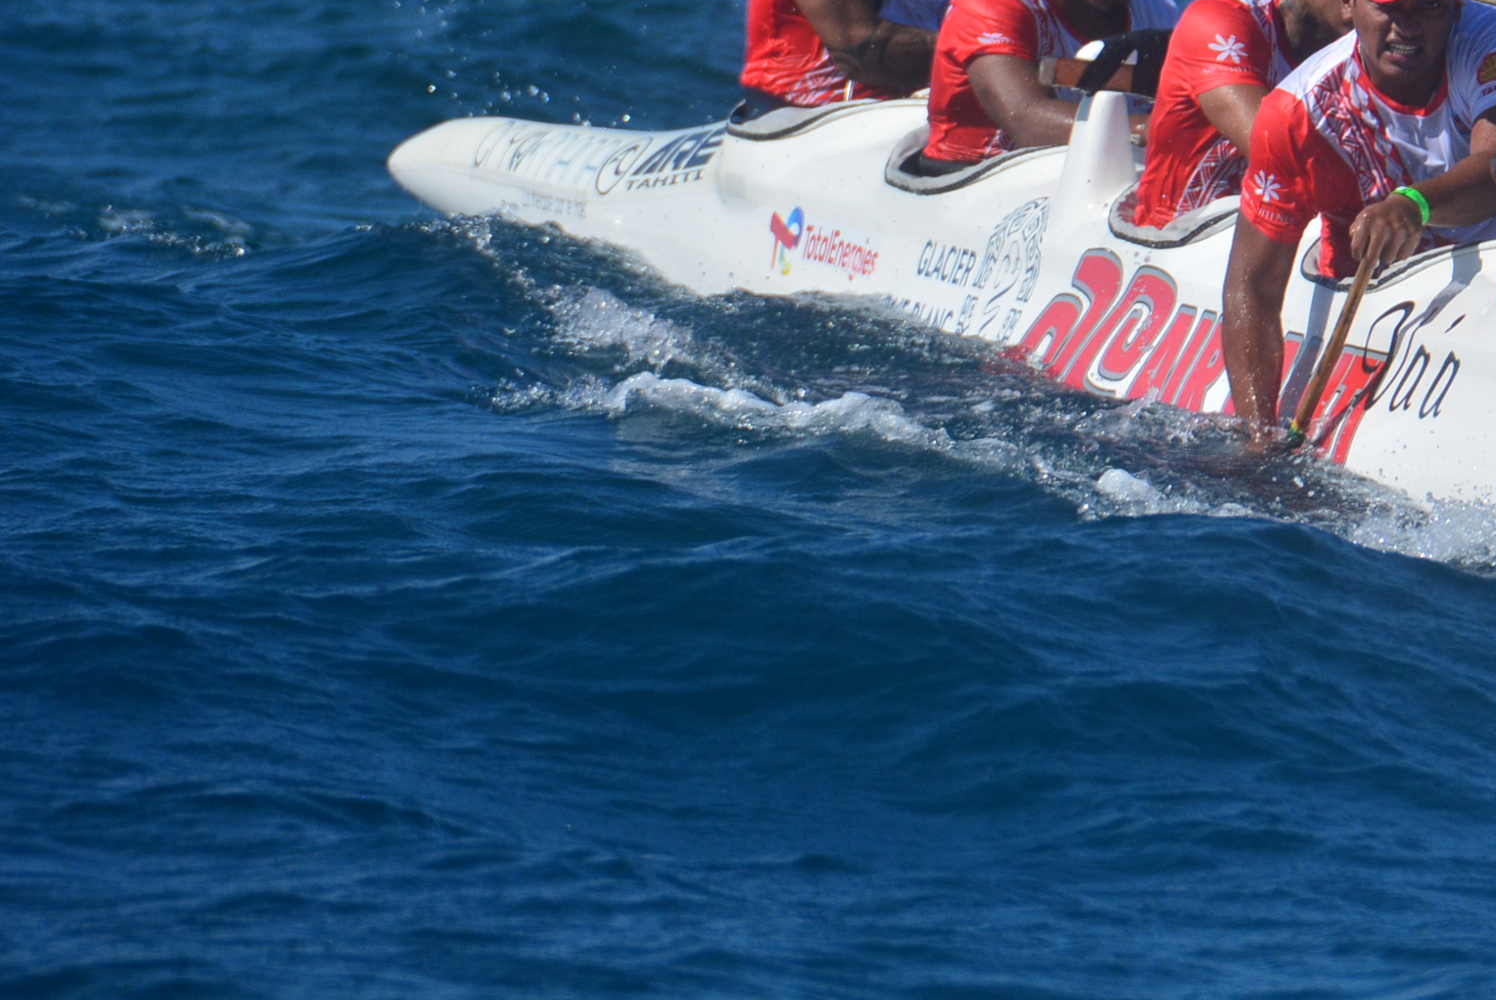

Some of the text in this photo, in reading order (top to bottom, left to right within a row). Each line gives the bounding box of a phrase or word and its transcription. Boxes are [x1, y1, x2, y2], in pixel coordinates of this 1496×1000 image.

[626, 168, 706, 191] TAHITI
[803, 225, 880, 282] TotalEnergies
[916, 239, 978, 287] GLACIER
